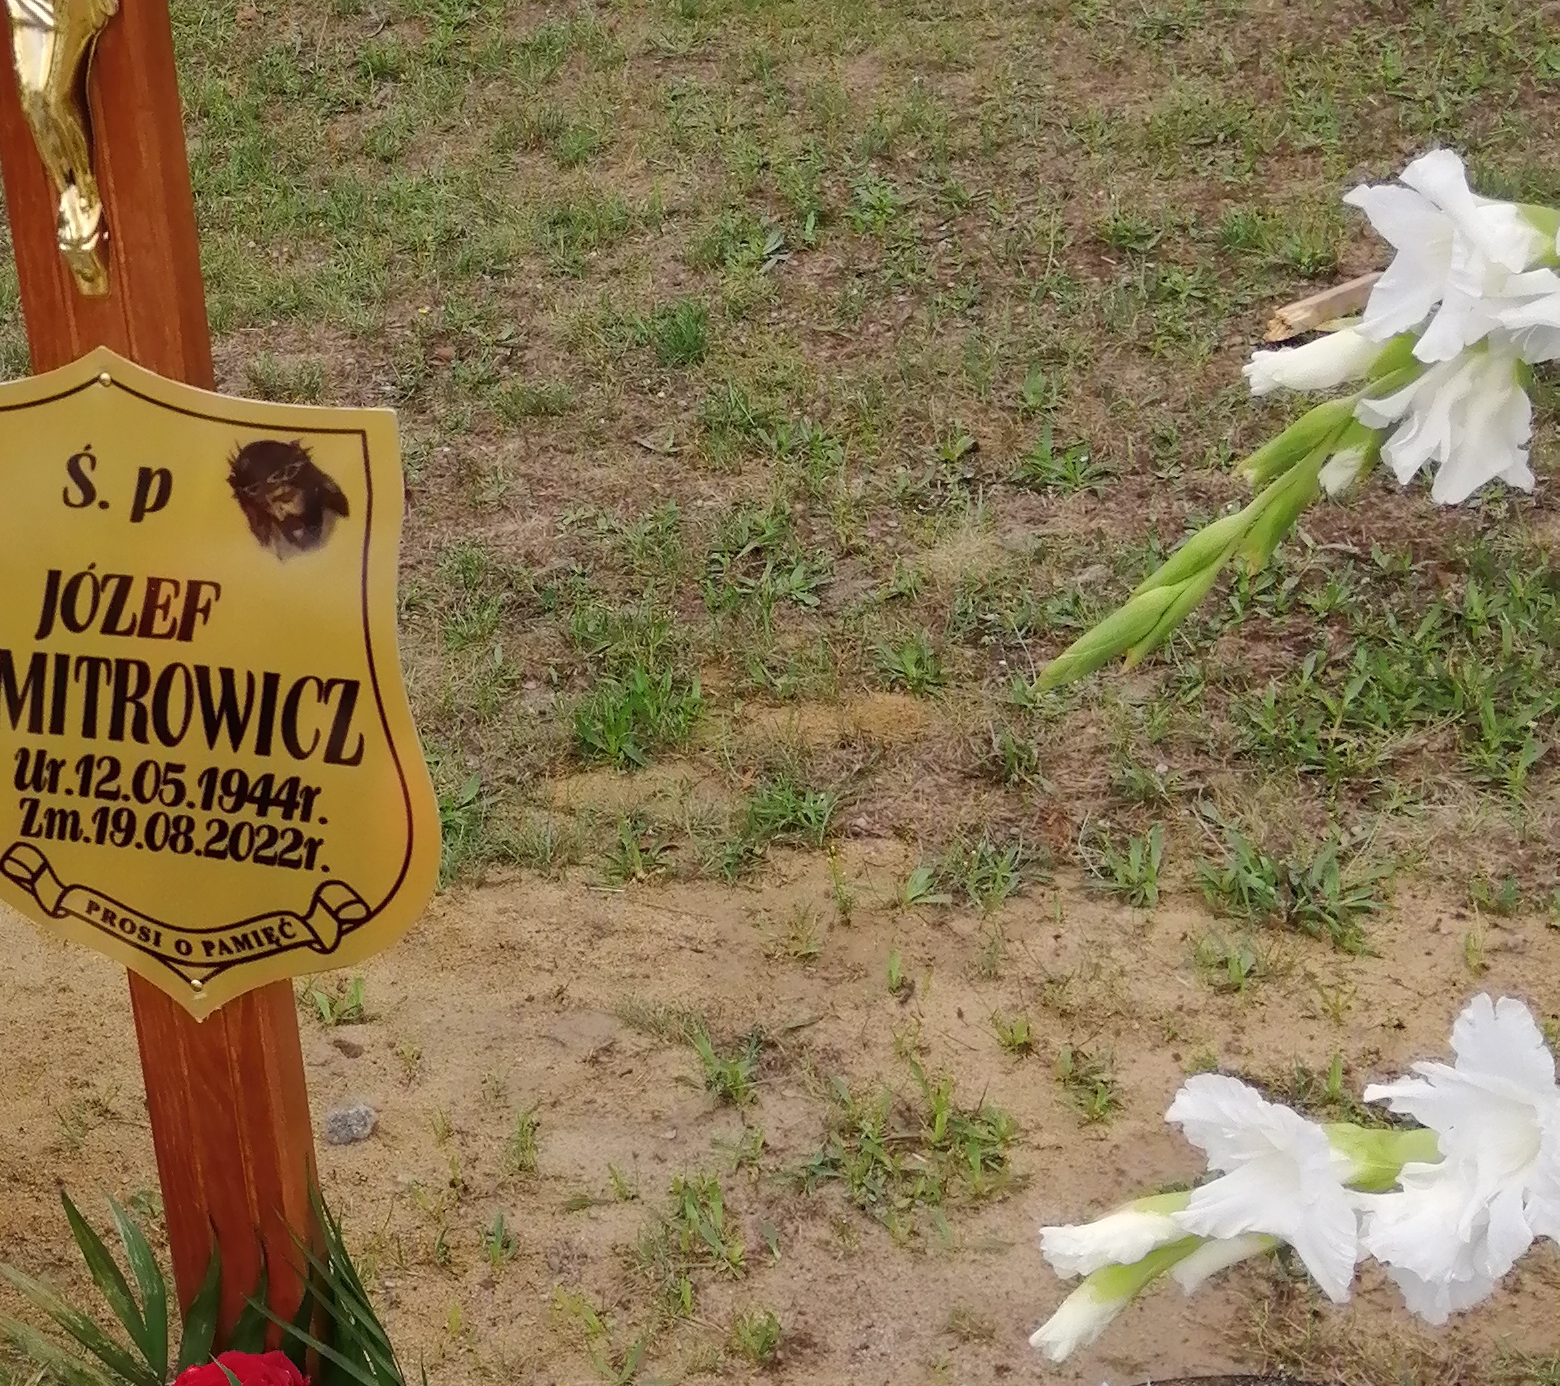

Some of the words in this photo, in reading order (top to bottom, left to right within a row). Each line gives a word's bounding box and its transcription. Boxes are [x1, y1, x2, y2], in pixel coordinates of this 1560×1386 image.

[61, 443, 110, 511] Ś.
[130, 463, 174, 523] p
[33, 562, 223, 644] JÓZEF
[85, 899, 163, 949] PROSI
[174, 938, 193, 958] O
[202, 918, 298, 958] PAMIĘĆ
